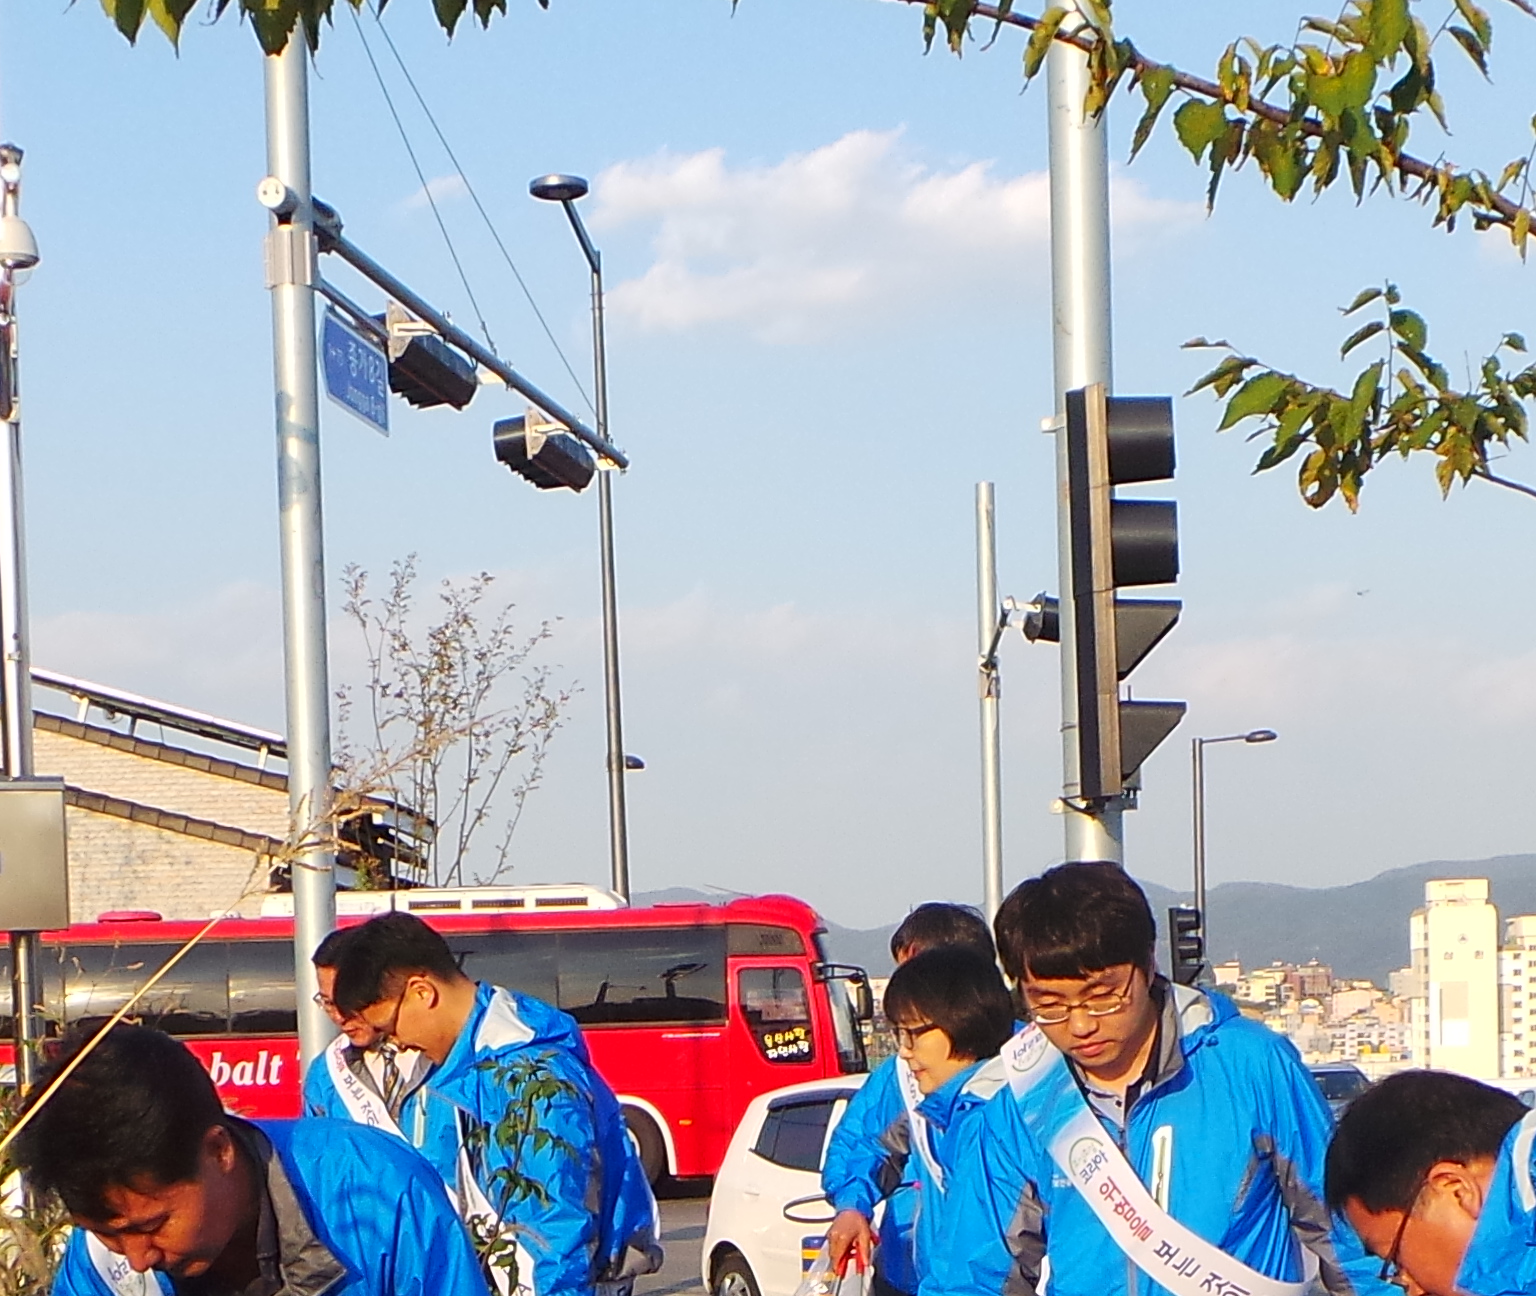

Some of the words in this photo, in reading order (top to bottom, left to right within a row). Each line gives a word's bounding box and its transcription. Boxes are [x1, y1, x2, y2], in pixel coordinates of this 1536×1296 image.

[1079, 1150, 1109, 1185] 코리아
[1099, 1175, 1154, 1242] 위험을
[1153, 1240, 1202, 1277] 보는
